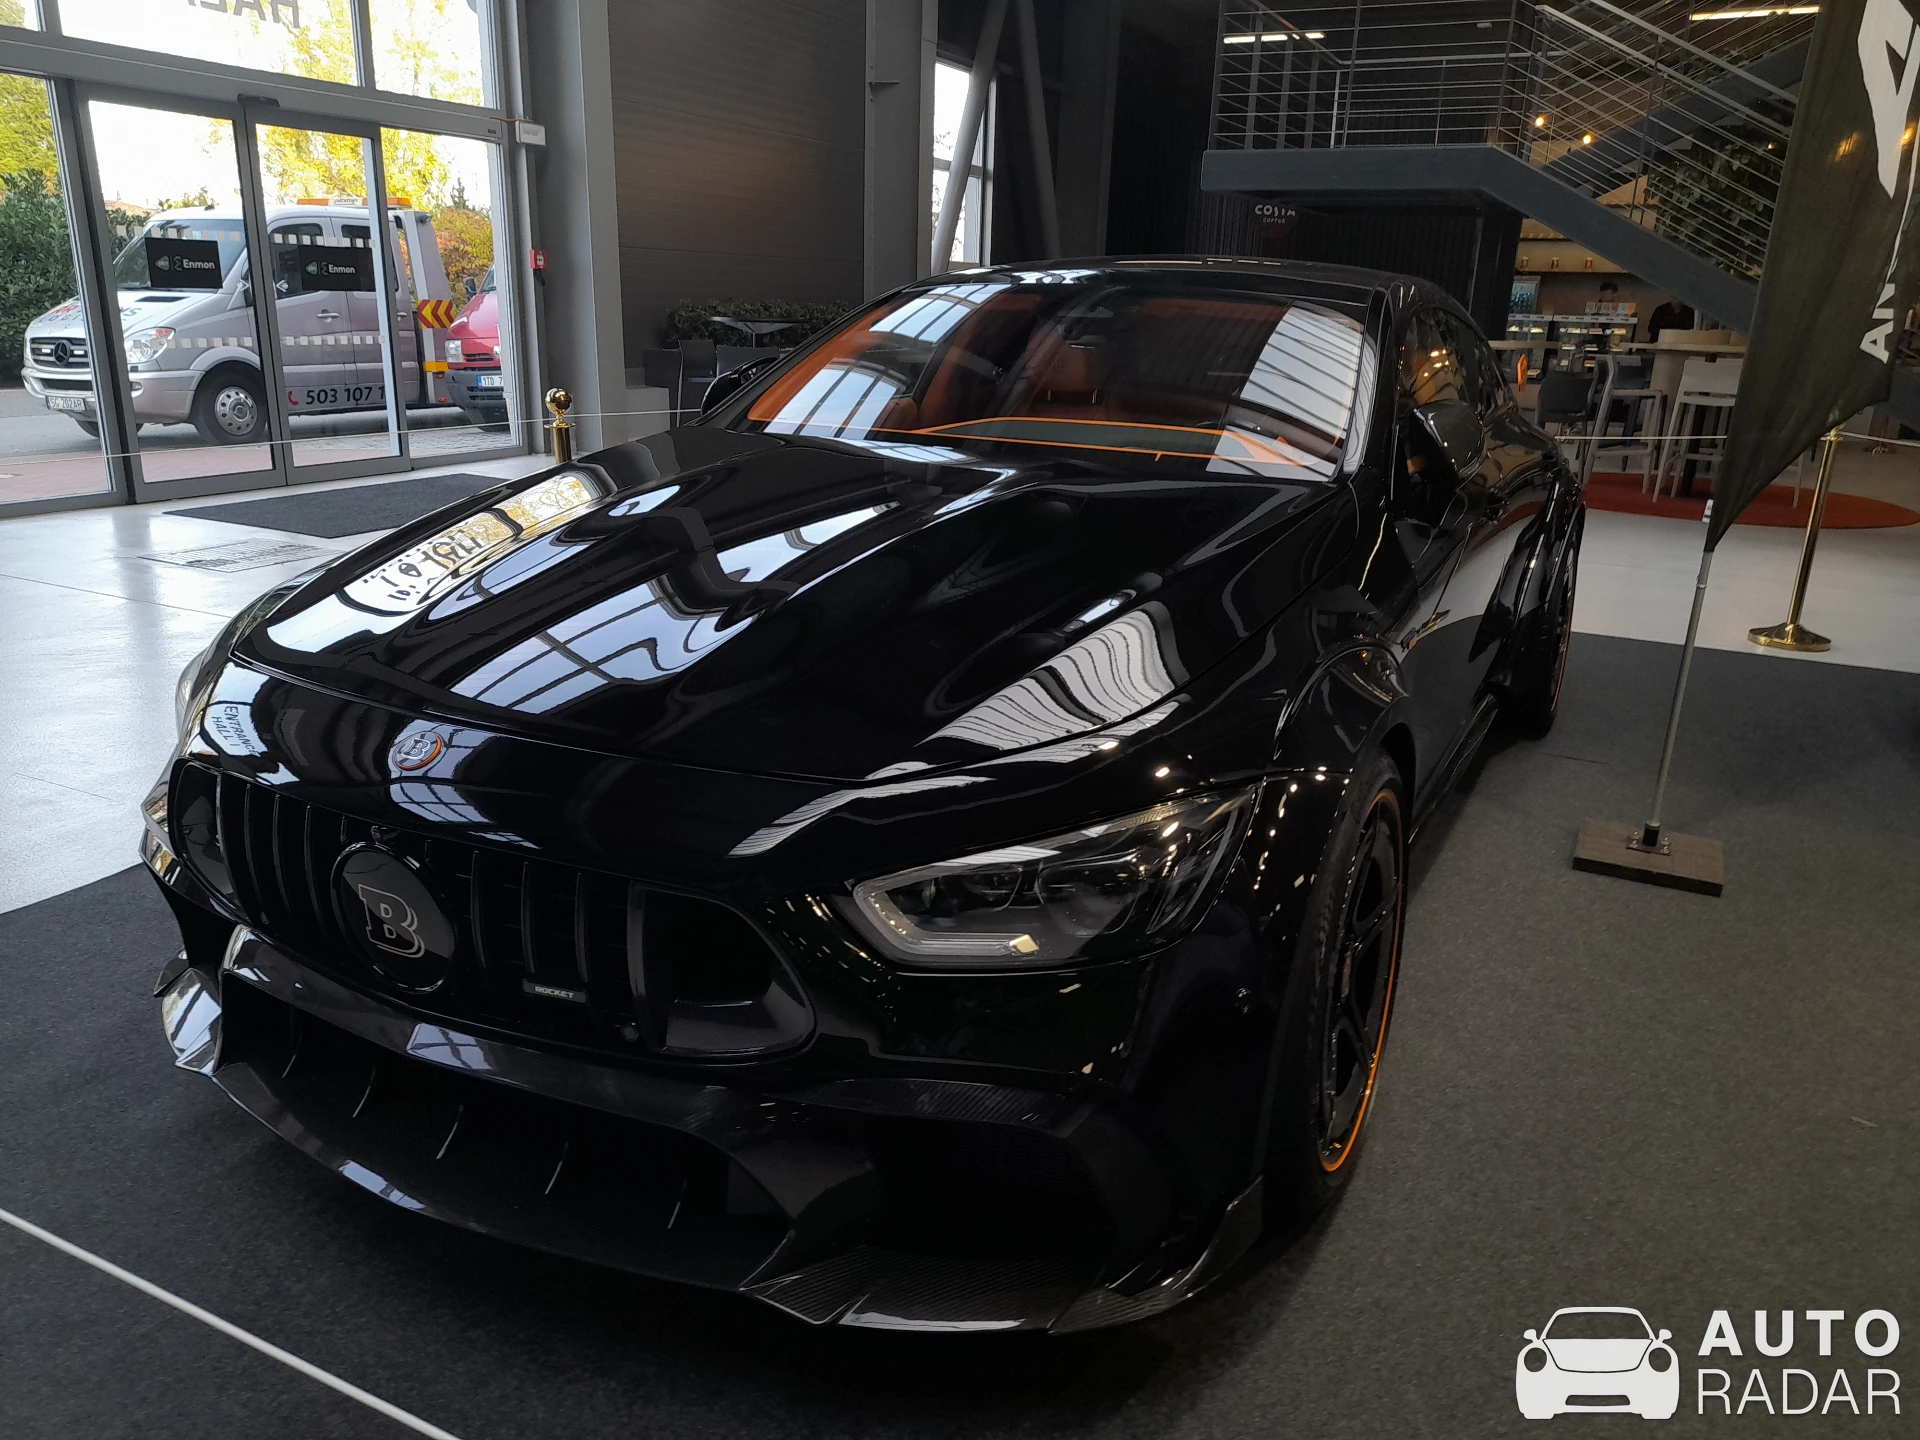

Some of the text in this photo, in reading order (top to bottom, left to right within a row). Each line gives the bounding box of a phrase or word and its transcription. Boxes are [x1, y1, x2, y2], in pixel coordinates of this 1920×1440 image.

[182, 258, 216, 270] Enmon
[328, 264, 356, 274] Enmon
[305, 388, 338, 405] 503
[344, 386, 373, 402] 107
[211, 716, 234, 740] HALL
[534, 986, 575, 999] ROCKET
